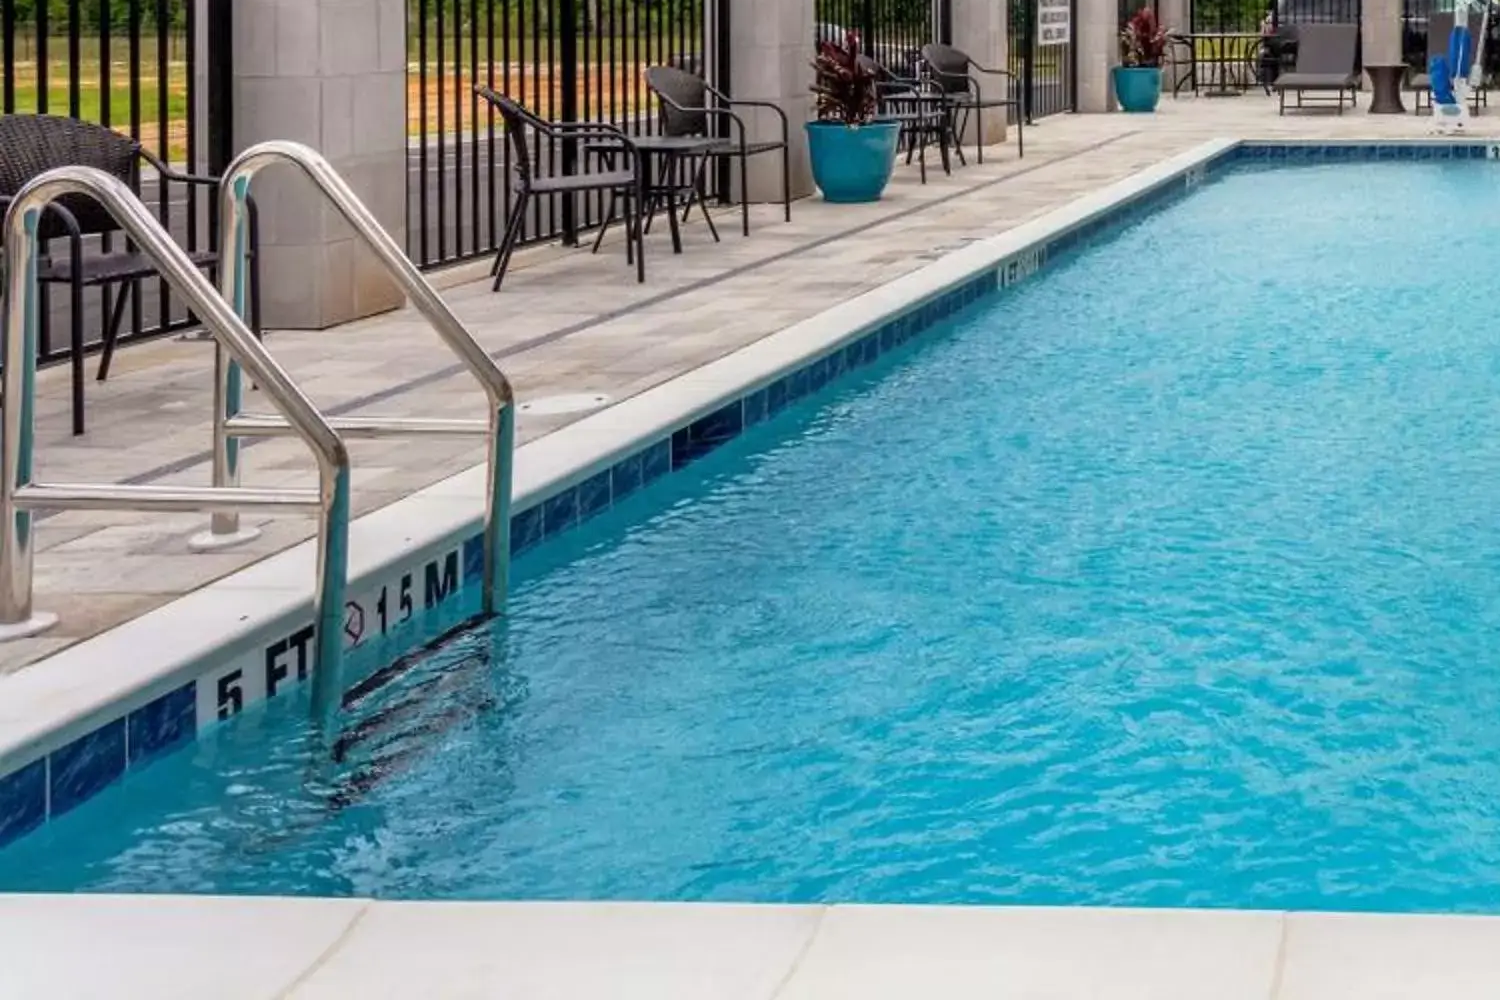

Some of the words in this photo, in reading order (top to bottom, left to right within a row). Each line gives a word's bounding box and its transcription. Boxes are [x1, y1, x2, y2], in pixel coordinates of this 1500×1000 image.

[217, 667, 242, 721] 5
[265, 622, 315, 699] FT
[424, 549, 459, 609] M
